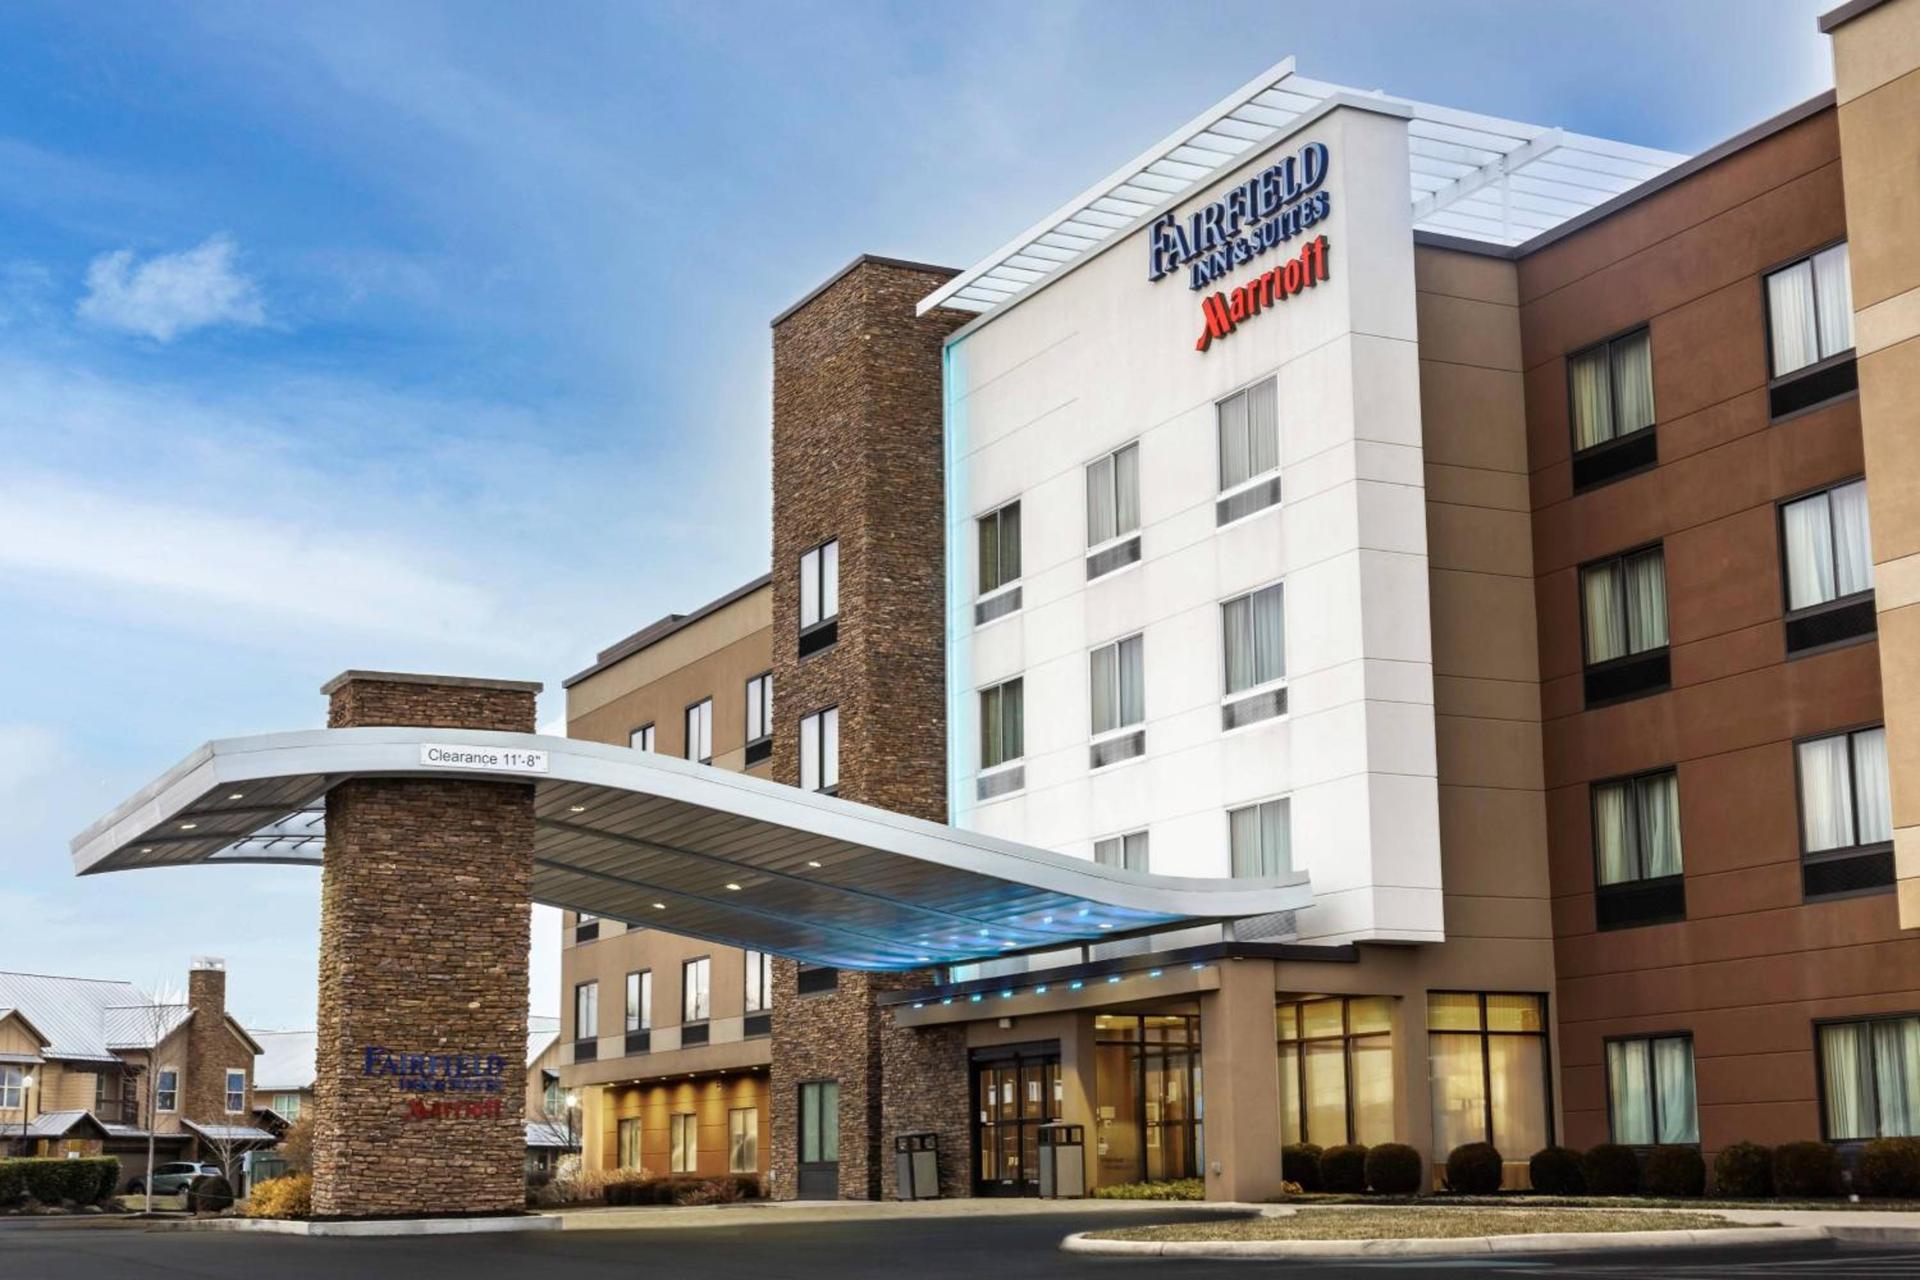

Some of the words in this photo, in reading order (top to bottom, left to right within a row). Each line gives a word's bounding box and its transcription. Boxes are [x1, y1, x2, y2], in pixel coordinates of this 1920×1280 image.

[1149, 142, 1329, 282] FAIRFIELD
[1196, 235, 1330, 352] Marriott
[428, 748, 498, 765] Clearance
[504, 753, 541, 768] 11'-8"
